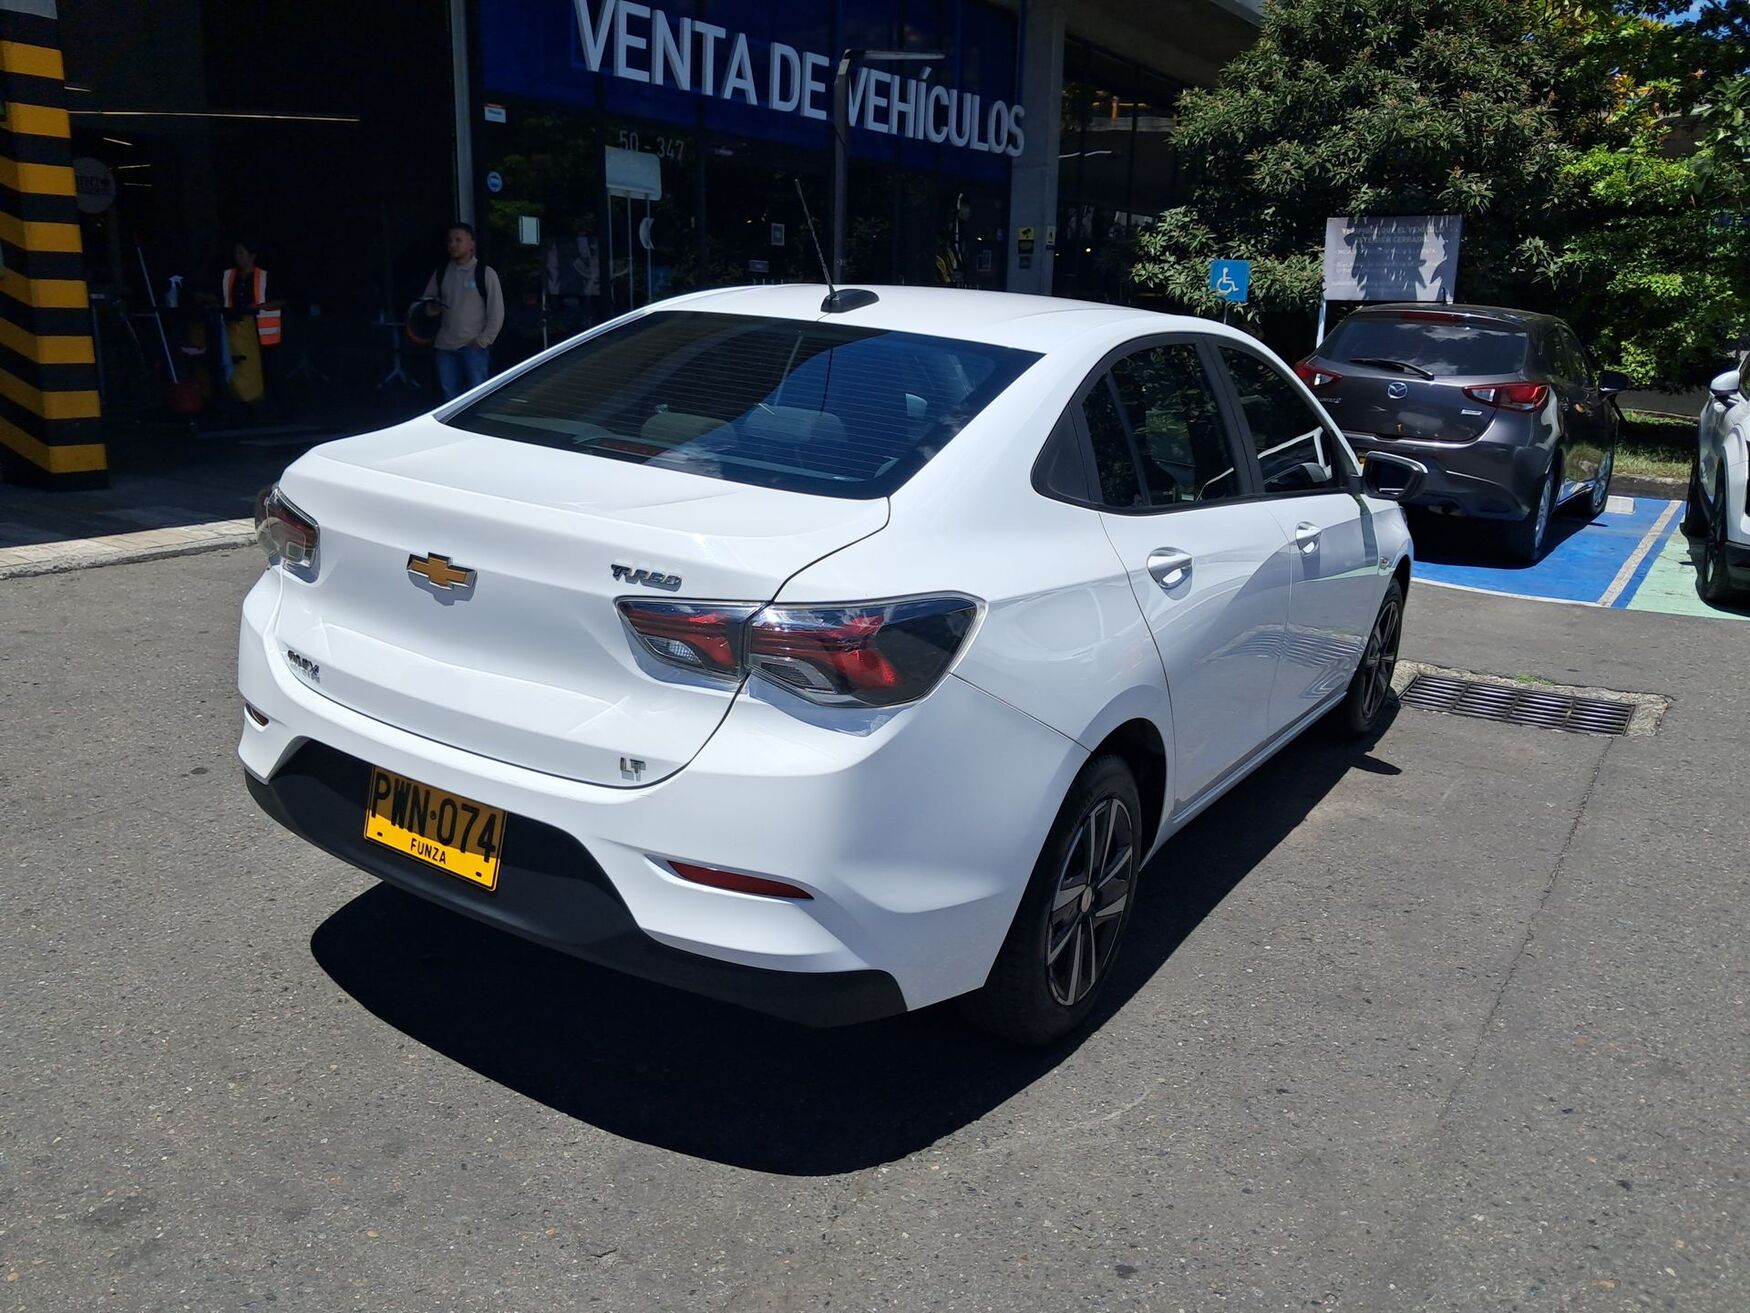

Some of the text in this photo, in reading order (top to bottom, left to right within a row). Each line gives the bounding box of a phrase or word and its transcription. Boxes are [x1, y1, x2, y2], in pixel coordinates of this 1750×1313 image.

[574, 0, 1025, 157] VENTA DE VEHÍCULOS
[656, 136, 686, 163] 347
[611, 564, 683, 588] TURBO
[620, 757, 646, 774] LT
[410, 837, 447, 864] FUNZA
